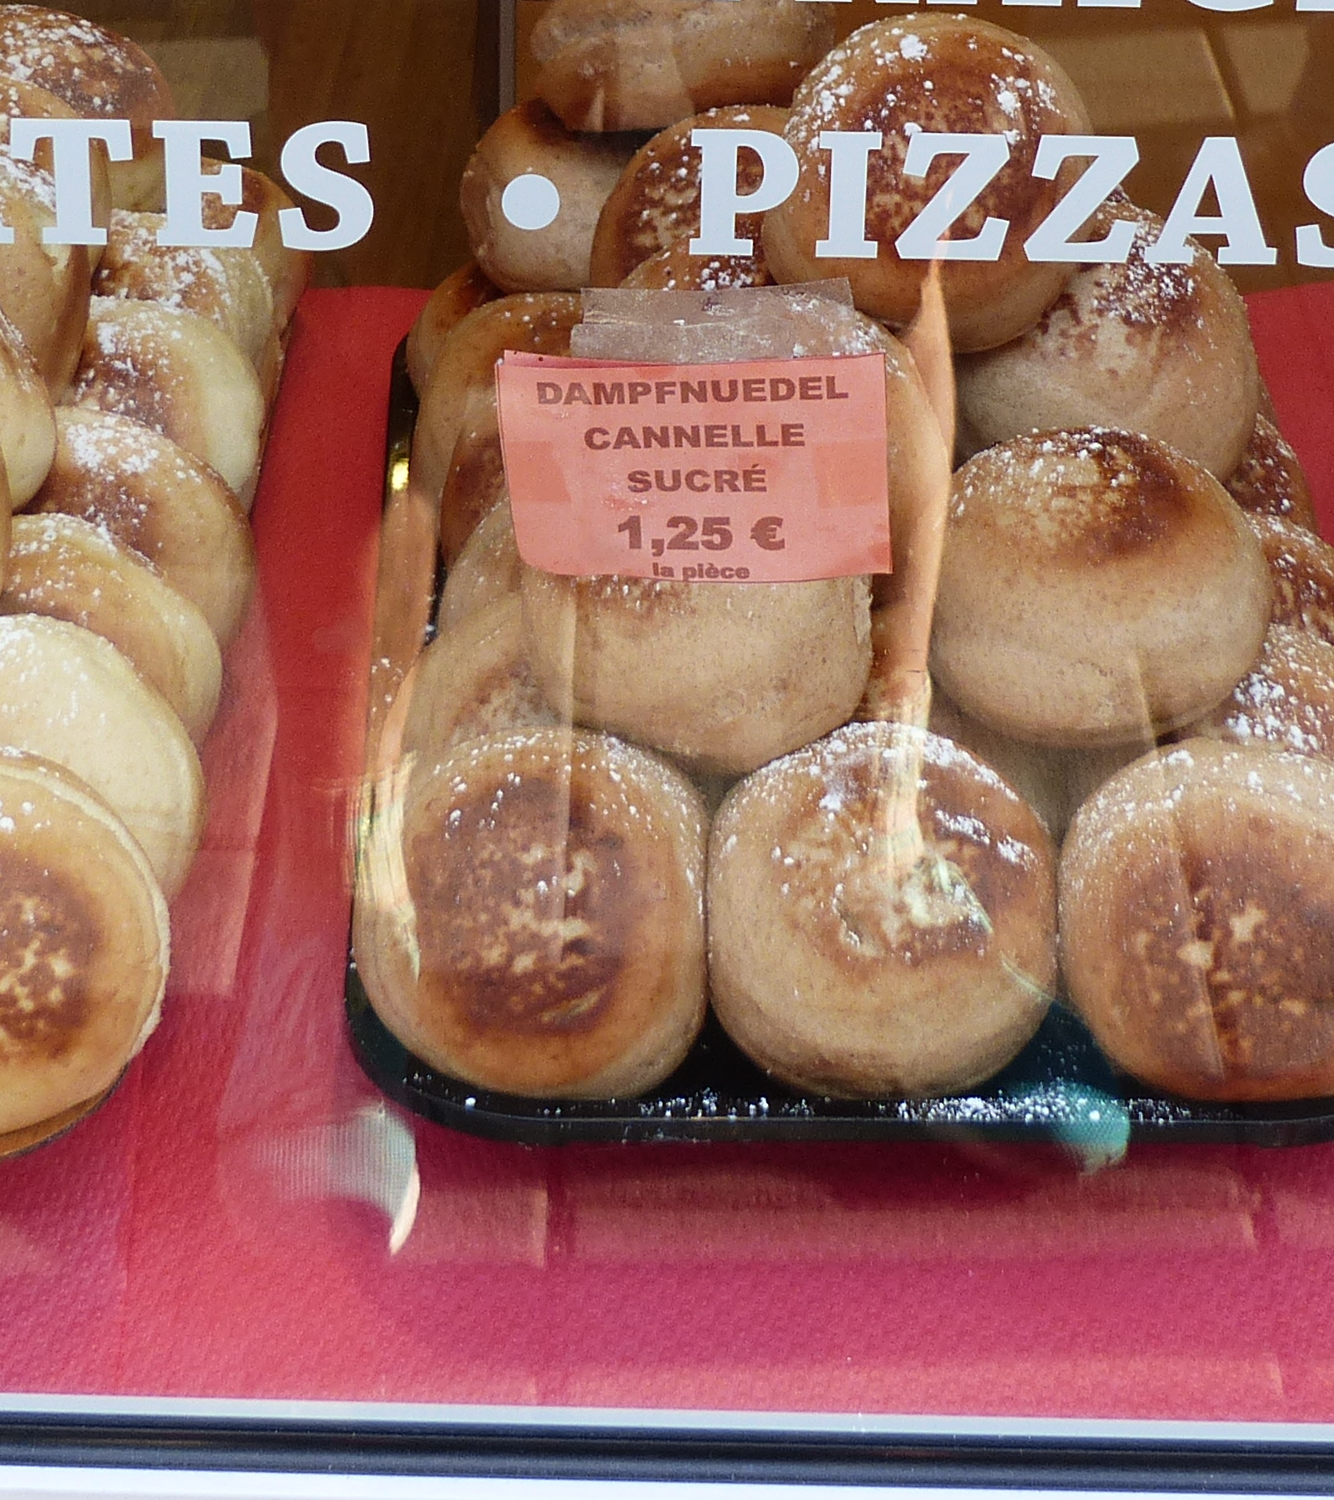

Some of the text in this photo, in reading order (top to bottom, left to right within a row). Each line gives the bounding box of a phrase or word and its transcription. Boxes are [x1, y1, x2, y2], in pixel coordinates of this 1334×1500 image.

[536, 375, 850, 406] DAMPFNUEDEL
[583, 423, 806, 451] CANNELLE
[626, 464, 768, 494] SUCRÉ
[617, 515, 786, 558] 1,25 €
[652, 561, 751, 582] la pièce
